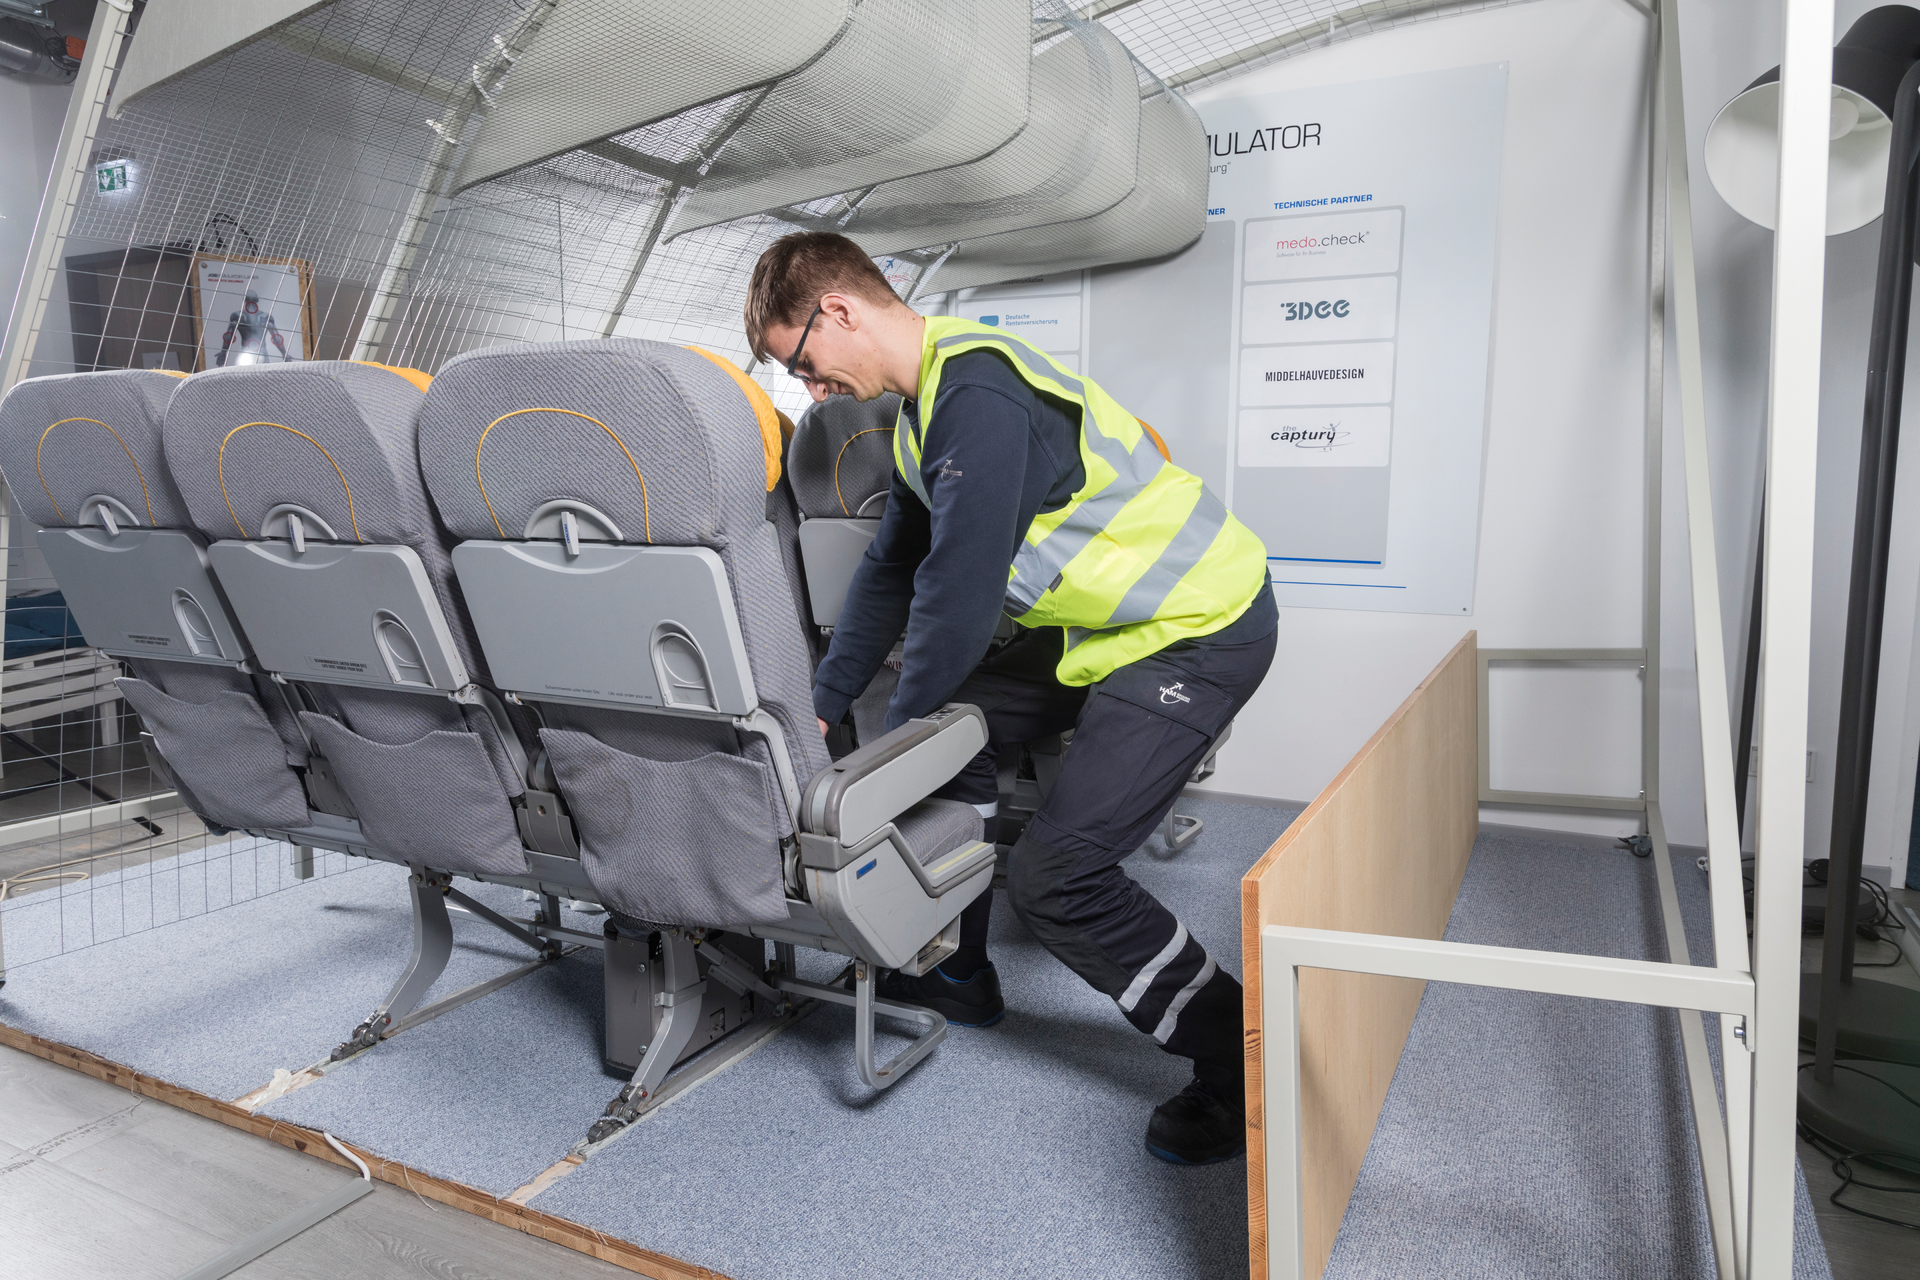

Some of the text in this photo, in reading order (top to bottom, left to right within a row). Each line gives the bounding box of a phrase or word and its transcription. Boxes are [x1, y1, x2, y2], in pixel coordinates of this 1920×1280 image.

[1273, 194, 1373, 210] TECHNISCHE PARTNER
[1265, 368, 1365, 382] MIDDELHAUVEDESIGN
[1270, 430, 1336, 443] captury
[1159, 686, 1177, 697] HAM
